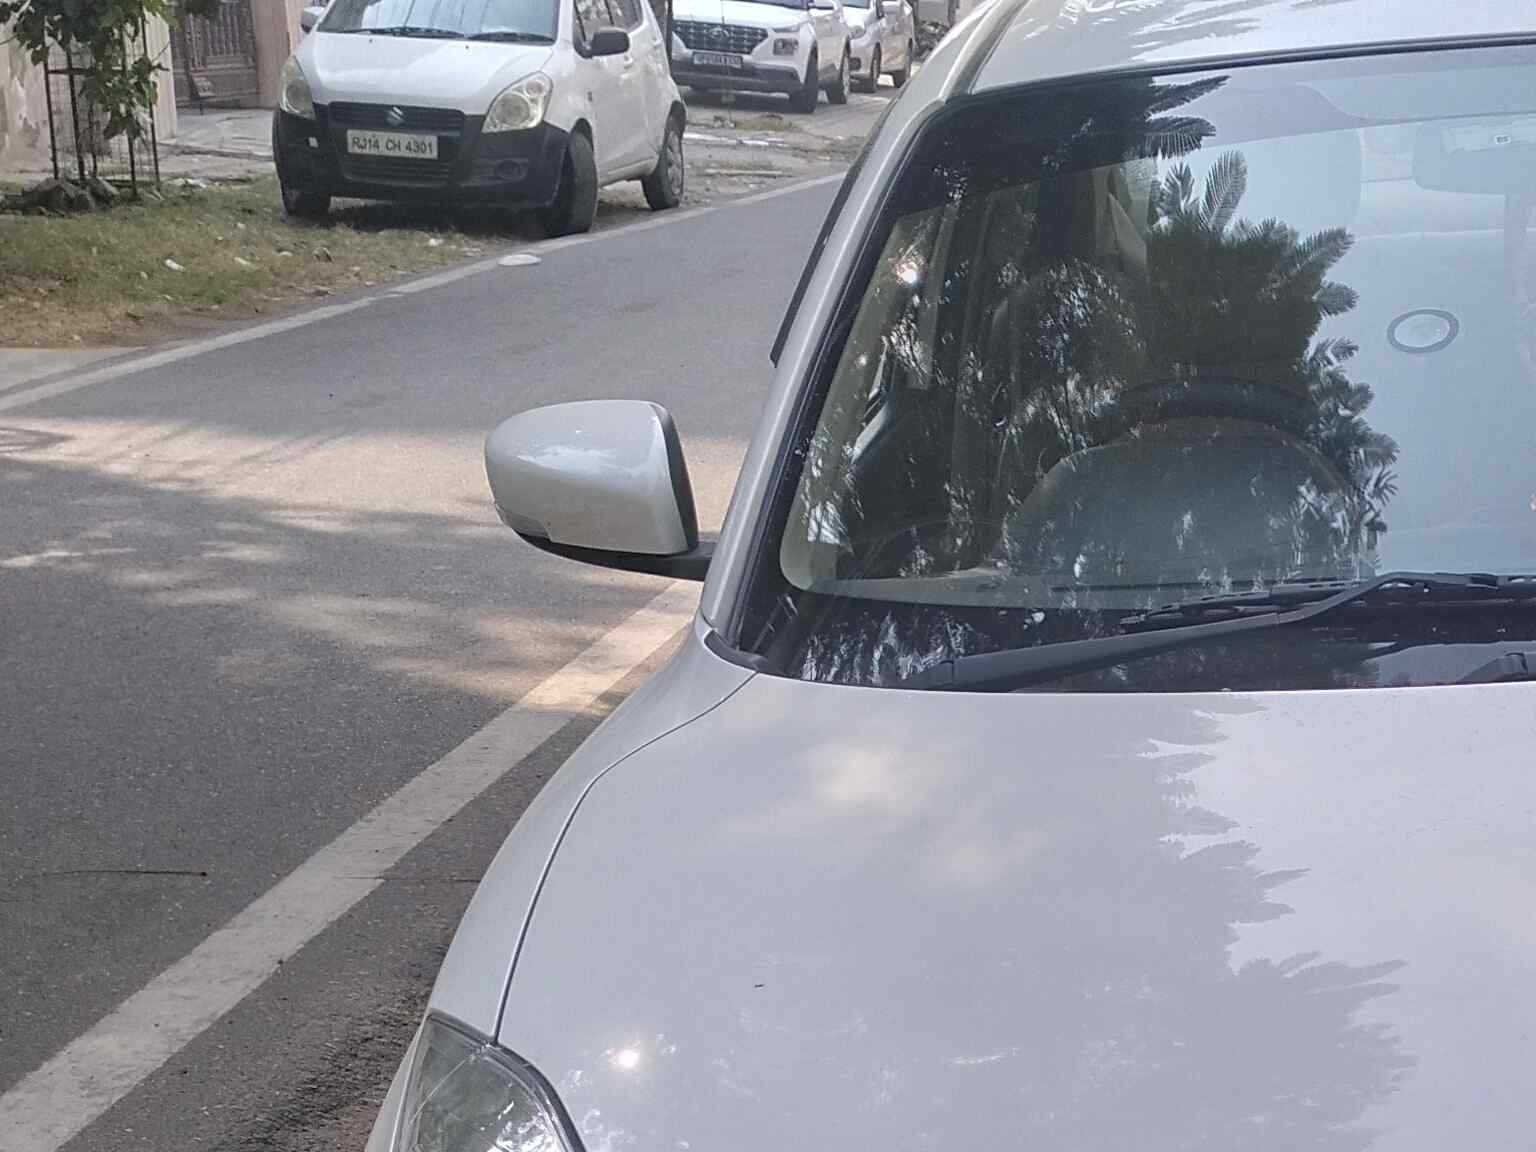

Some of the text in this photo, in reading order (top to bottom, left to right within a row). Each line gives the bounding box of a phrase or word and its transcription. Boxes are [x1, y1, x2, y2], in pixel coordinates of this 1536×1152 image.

[351, 136, 433, 155] RJ14 CH 4301
